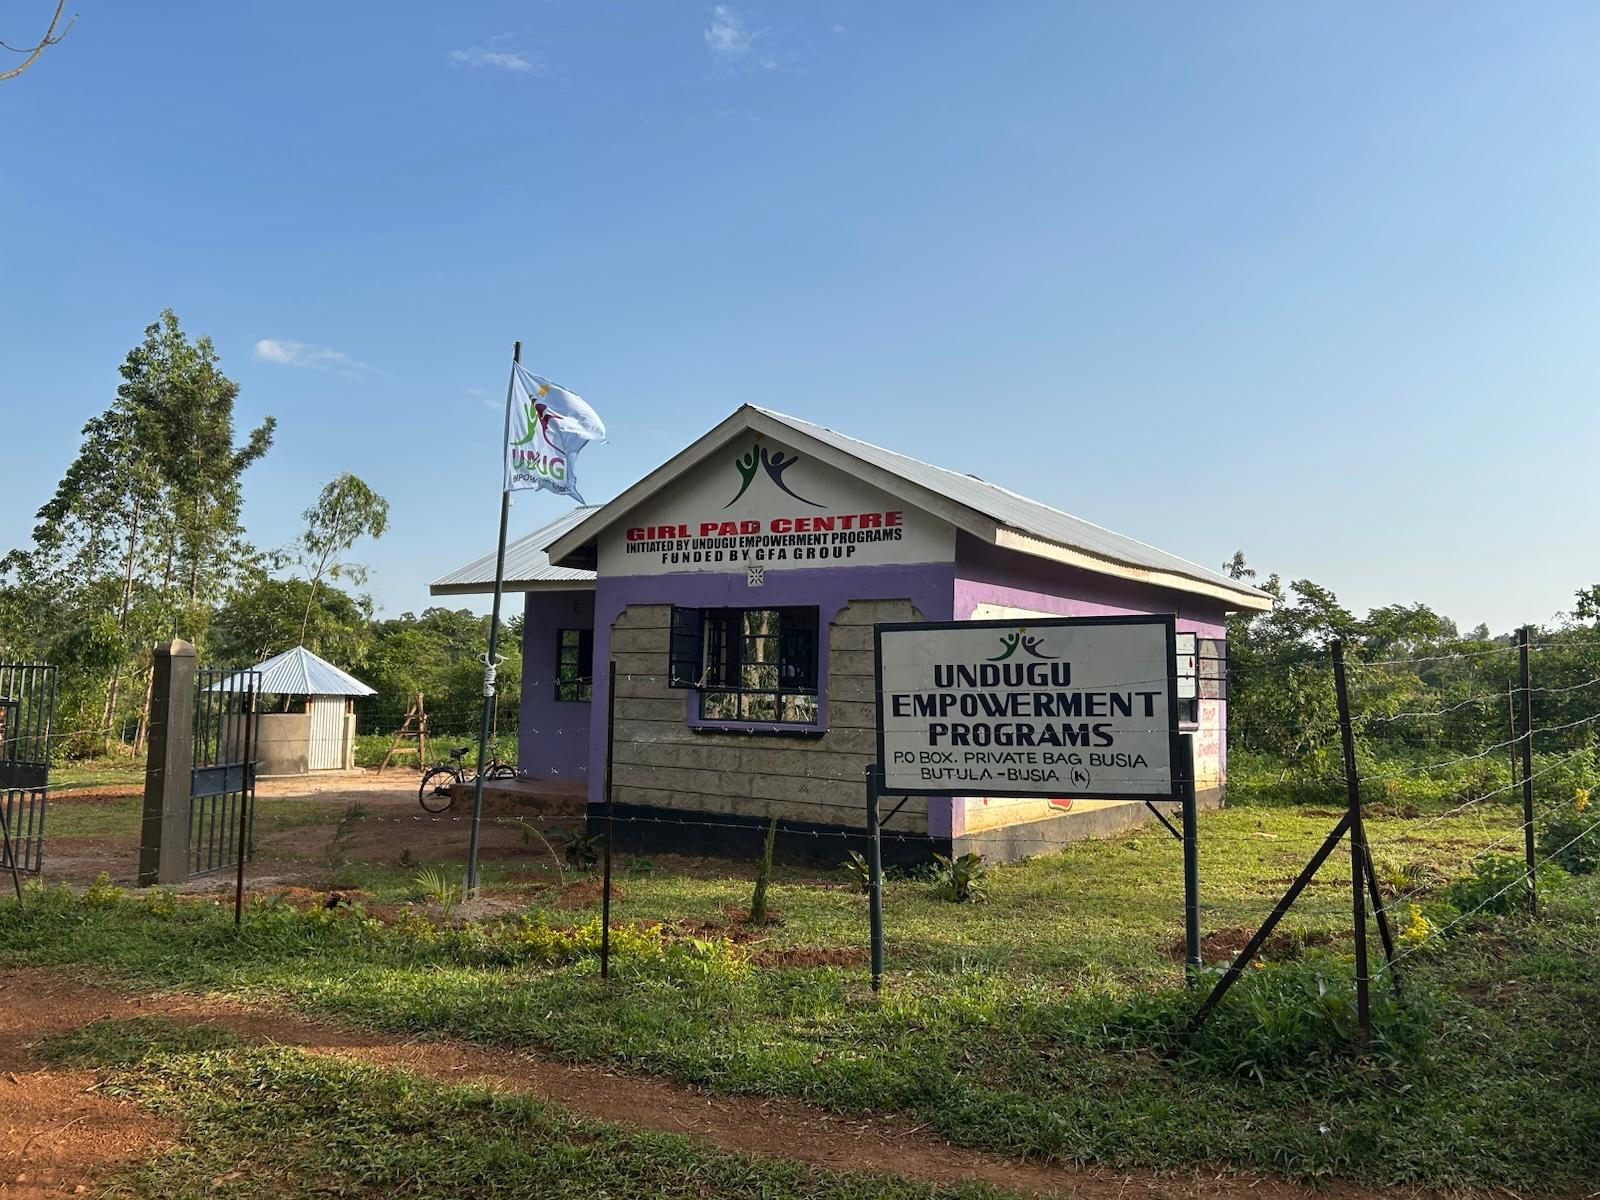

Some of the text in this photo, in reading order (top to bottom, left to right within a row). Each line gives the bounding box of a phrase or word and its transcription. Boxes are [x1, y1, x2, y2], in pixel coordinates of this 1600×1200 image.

[626, 511, 903, 542] GIRL PAD CENTRE
[626, 528, 903, 554] INITIATED BY UNDUGU EMPOWERMENT PROGRAMS
[662, 545, 856, 564] FUNDED BY GFA GROUP
[934, 662, 1071, 688] UNDUGU
[892, 692, 1162, 717] EMPOWERMENT
[929, 723, 1114, 747] PROGRAMS
[919, 751, 958, 764] BOX.
[964, 752, 1037, 764] PRIVATE
[1043, 752, 1082, 765] BAG
[1089, 753, 1148, 768] BUSIA
[1070, 766, 1091, 789] (K)
